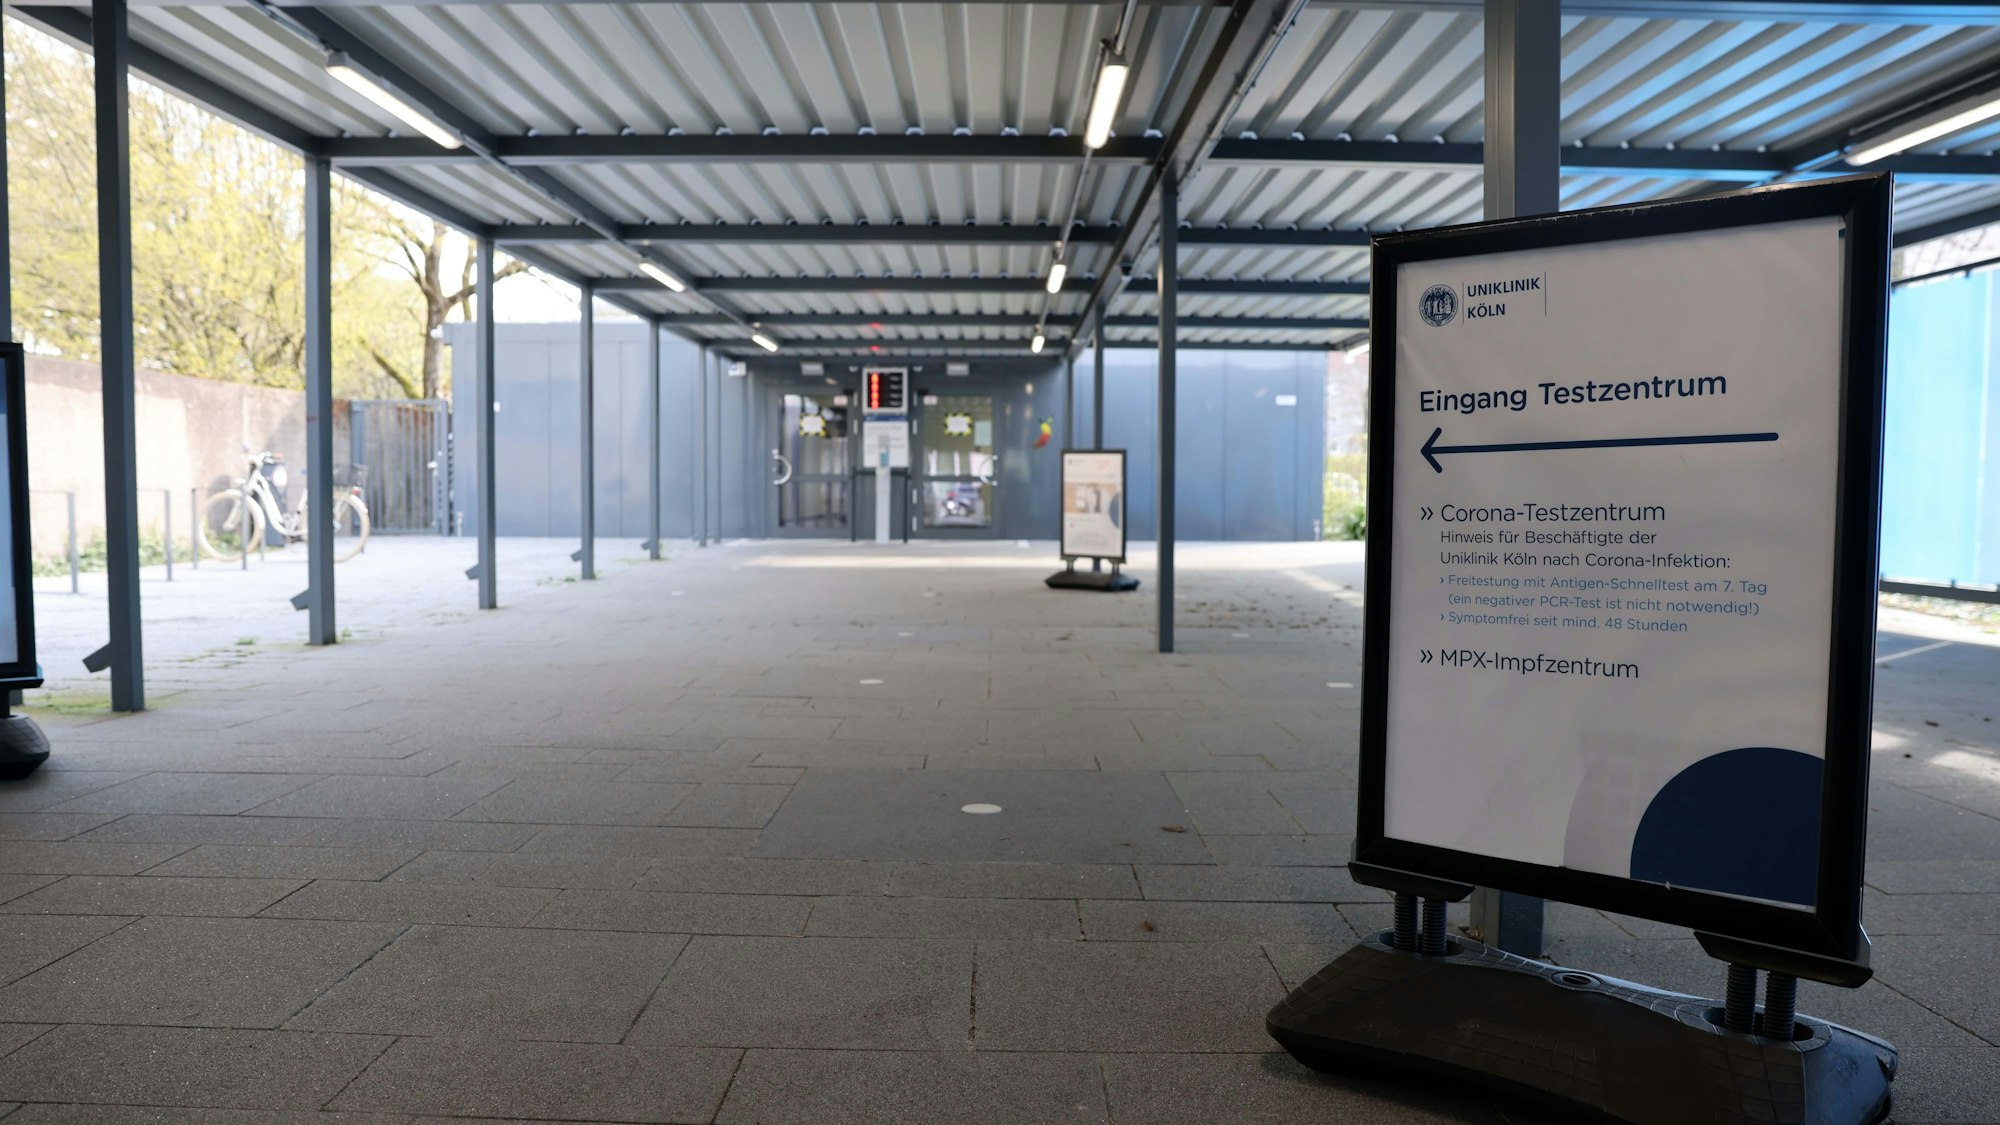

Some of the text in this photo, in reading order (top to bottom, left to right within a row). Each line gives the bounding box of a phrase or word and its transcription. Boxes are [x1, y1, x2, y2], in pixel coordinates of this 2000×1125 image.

[1467, 277, 1540, 298] UNIKLINIK
[1467, 302, 1506, 319] KÖLN
[1420, 375, 1727, 415] Eingang Testzentrum
[1441, 503, 1665, 522] Corona-Testzentrum
[1440, 530, 1657, 547] Hinweis für Beschäftigte der
[1440, 551, 1731, 569] Uniklinik Köln nach Corona-Infektion:
[1448, 574, 1767, 596] Freitestung mit Antigen-Schnelltest am 7. Tag
[1448, 592, 1760, 617] (ein negativer PCR-Test ist nicht notwendig!)
[1448, 611, 1688, 632] Symptomfrei seit mind. 48 Stunden
[1441, 648, 1639, 679] MPX-Impfzentrum
